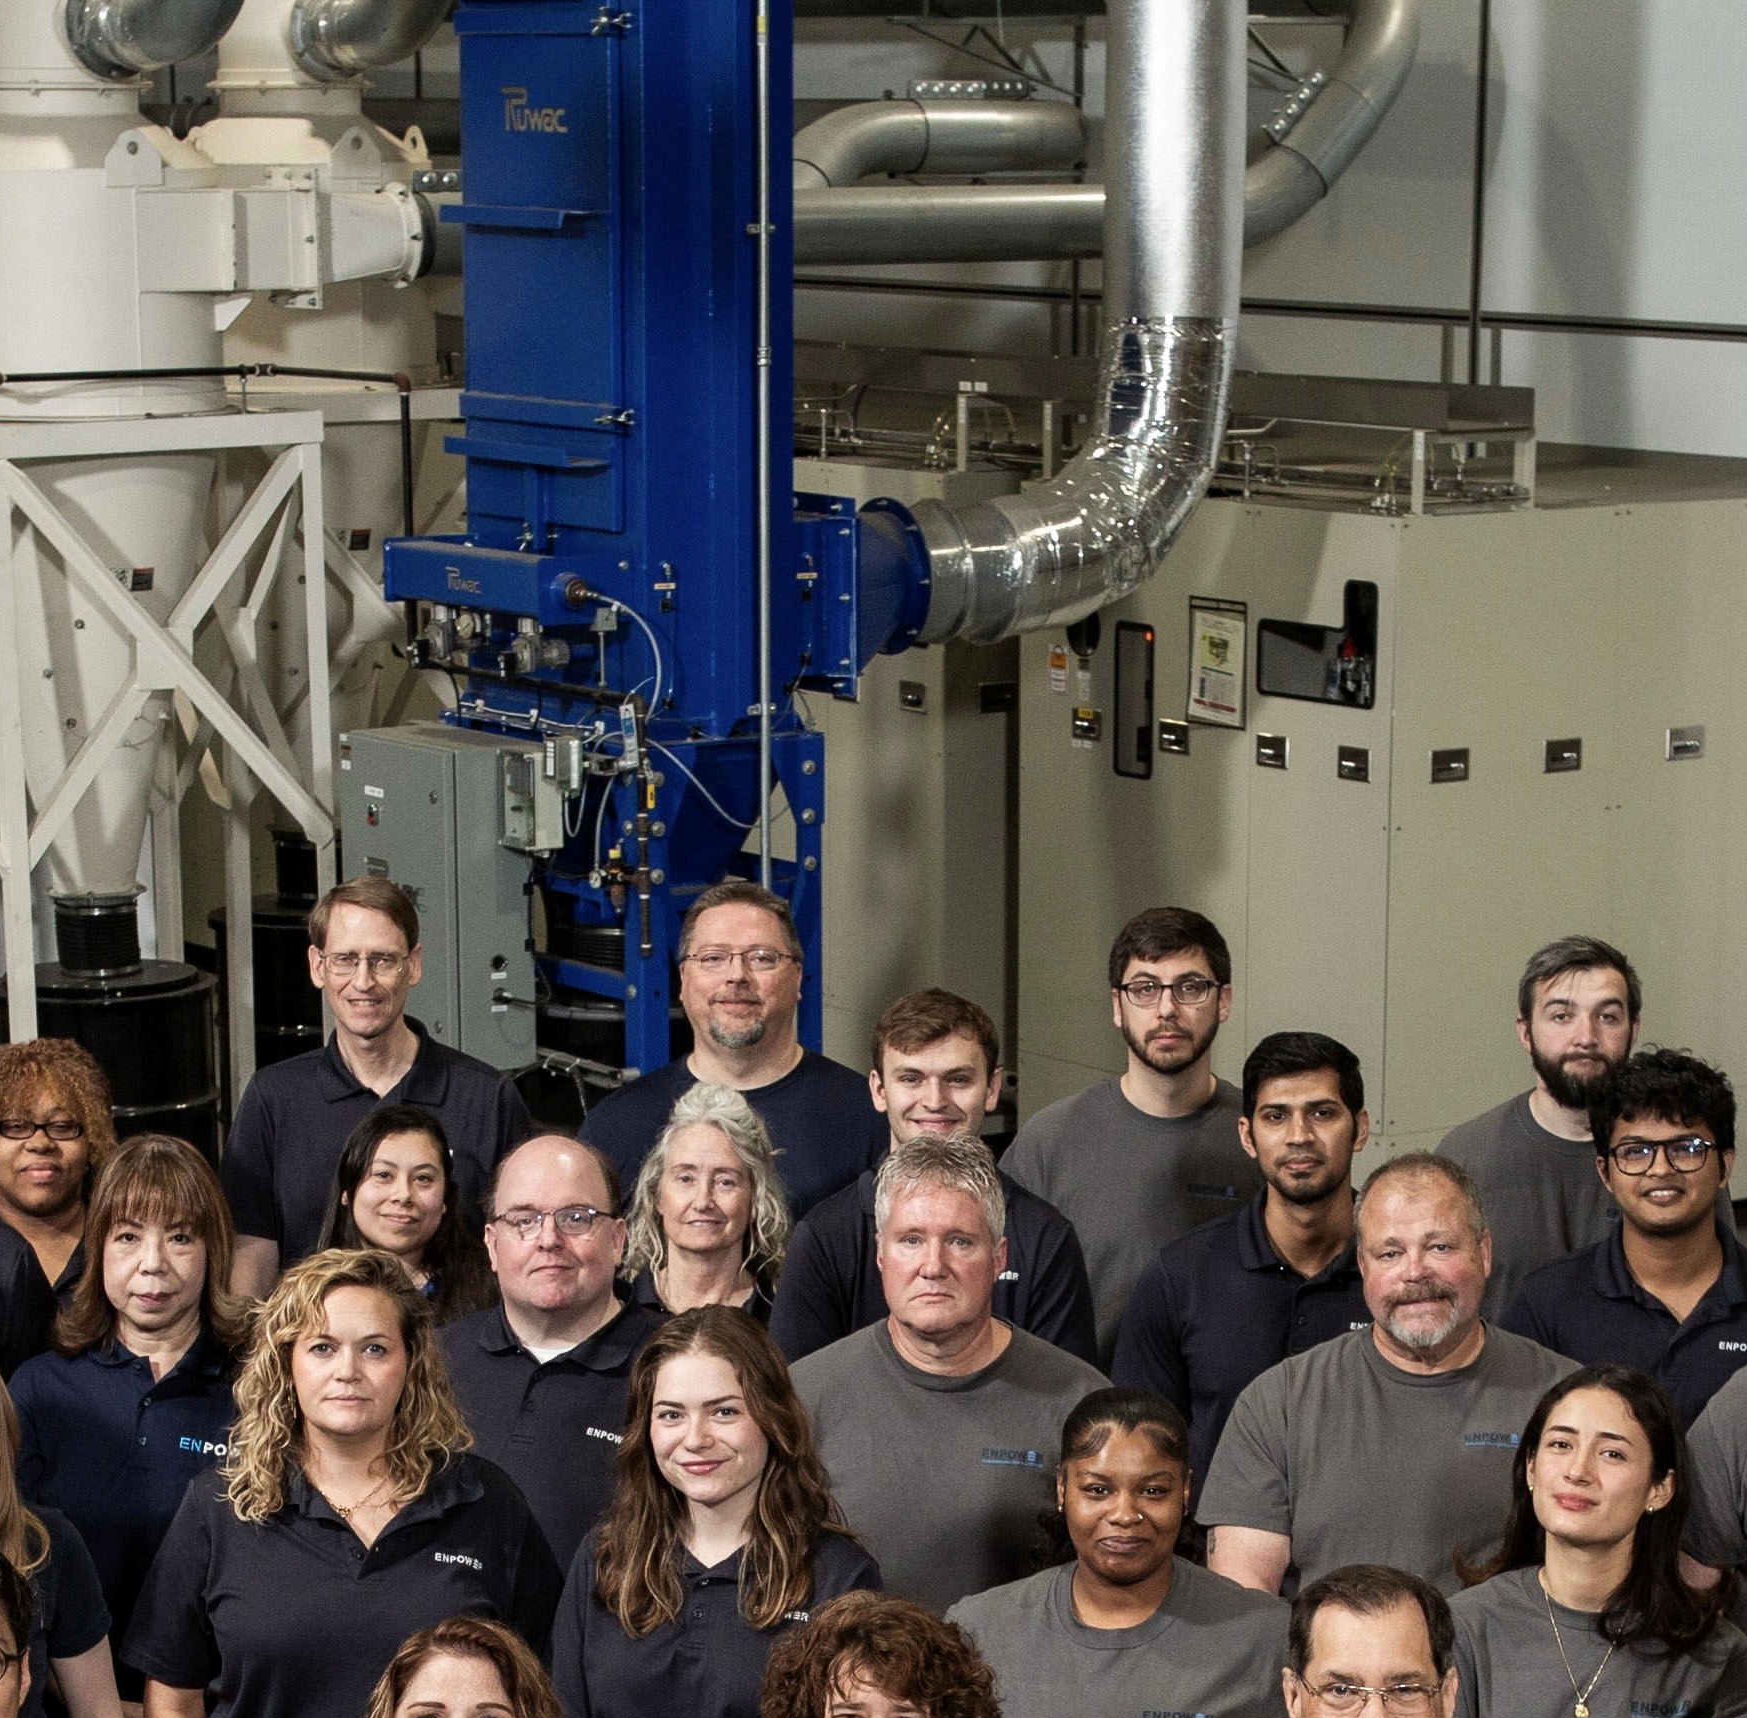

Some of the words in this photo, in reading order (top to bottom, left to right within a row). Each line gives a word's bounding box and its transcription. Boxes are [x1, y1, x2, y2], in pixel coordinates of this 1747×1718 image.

[586, 1427, 623, 1444] ENPOW
[1464, 1432, 1520, 1445] ENPOWE
[179, 1437, 237, 1457] ENPO
[434, 1552, 482, 1570] ENPOWER
